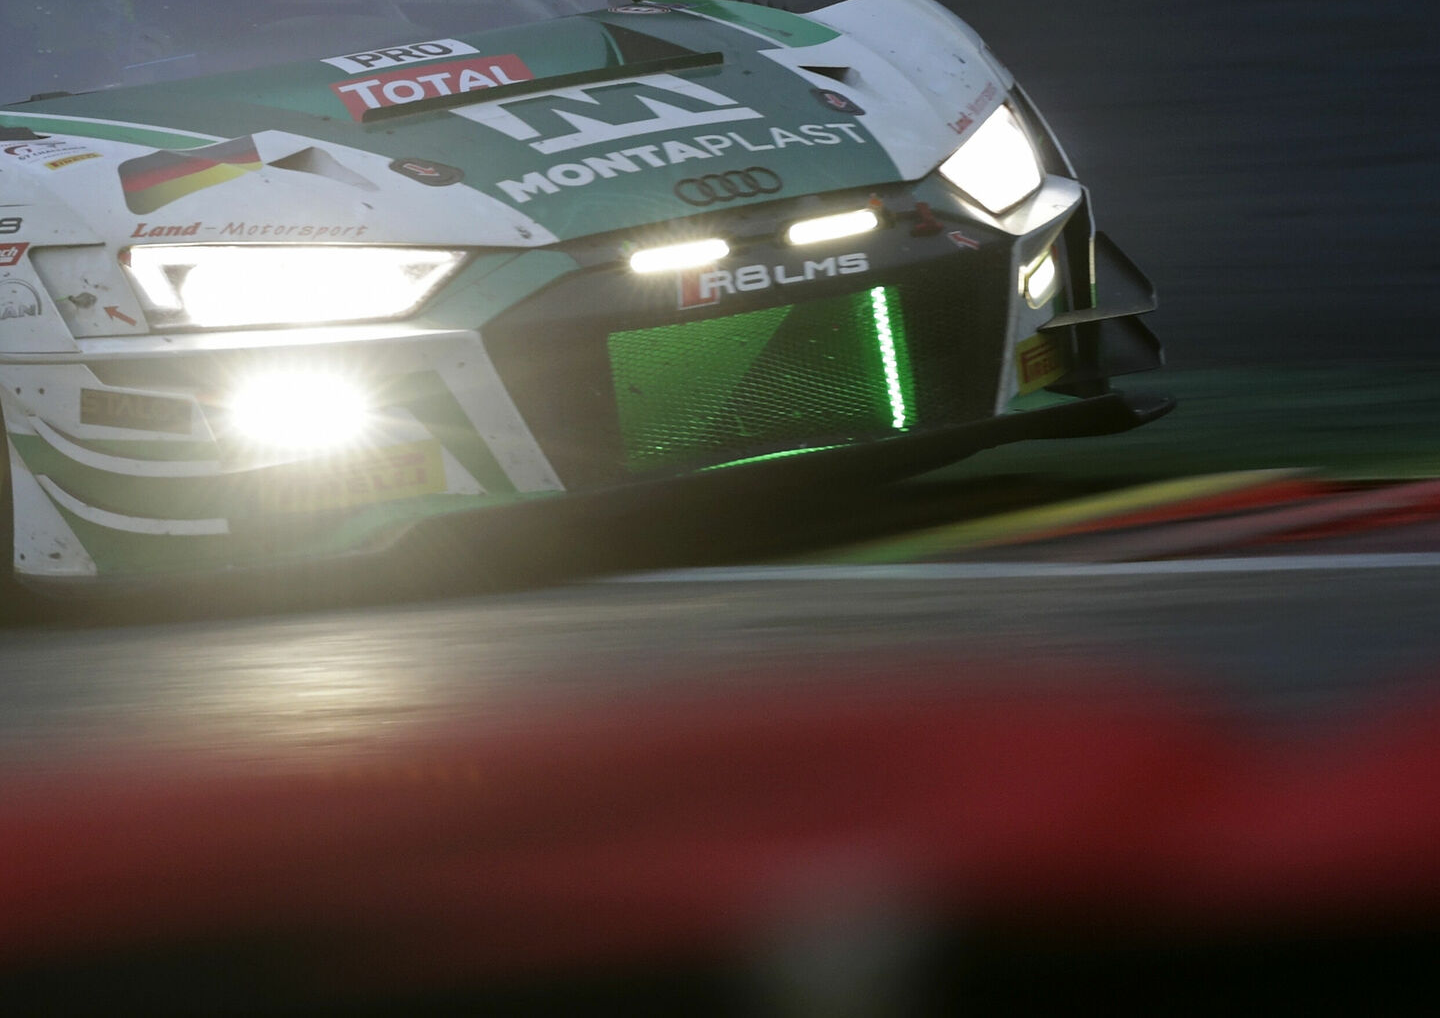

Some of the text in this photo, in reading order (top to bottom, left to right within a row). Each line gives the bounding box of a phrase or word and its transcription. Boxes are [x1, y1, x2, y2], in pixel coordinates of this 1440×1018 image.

[344, 43, 453, 68] PRO
[338, 65, 530, 109] TOTAL
[494, 120, 867, 205] MONTAPLAST
[698, 252, 871, 300] R8 LMS
